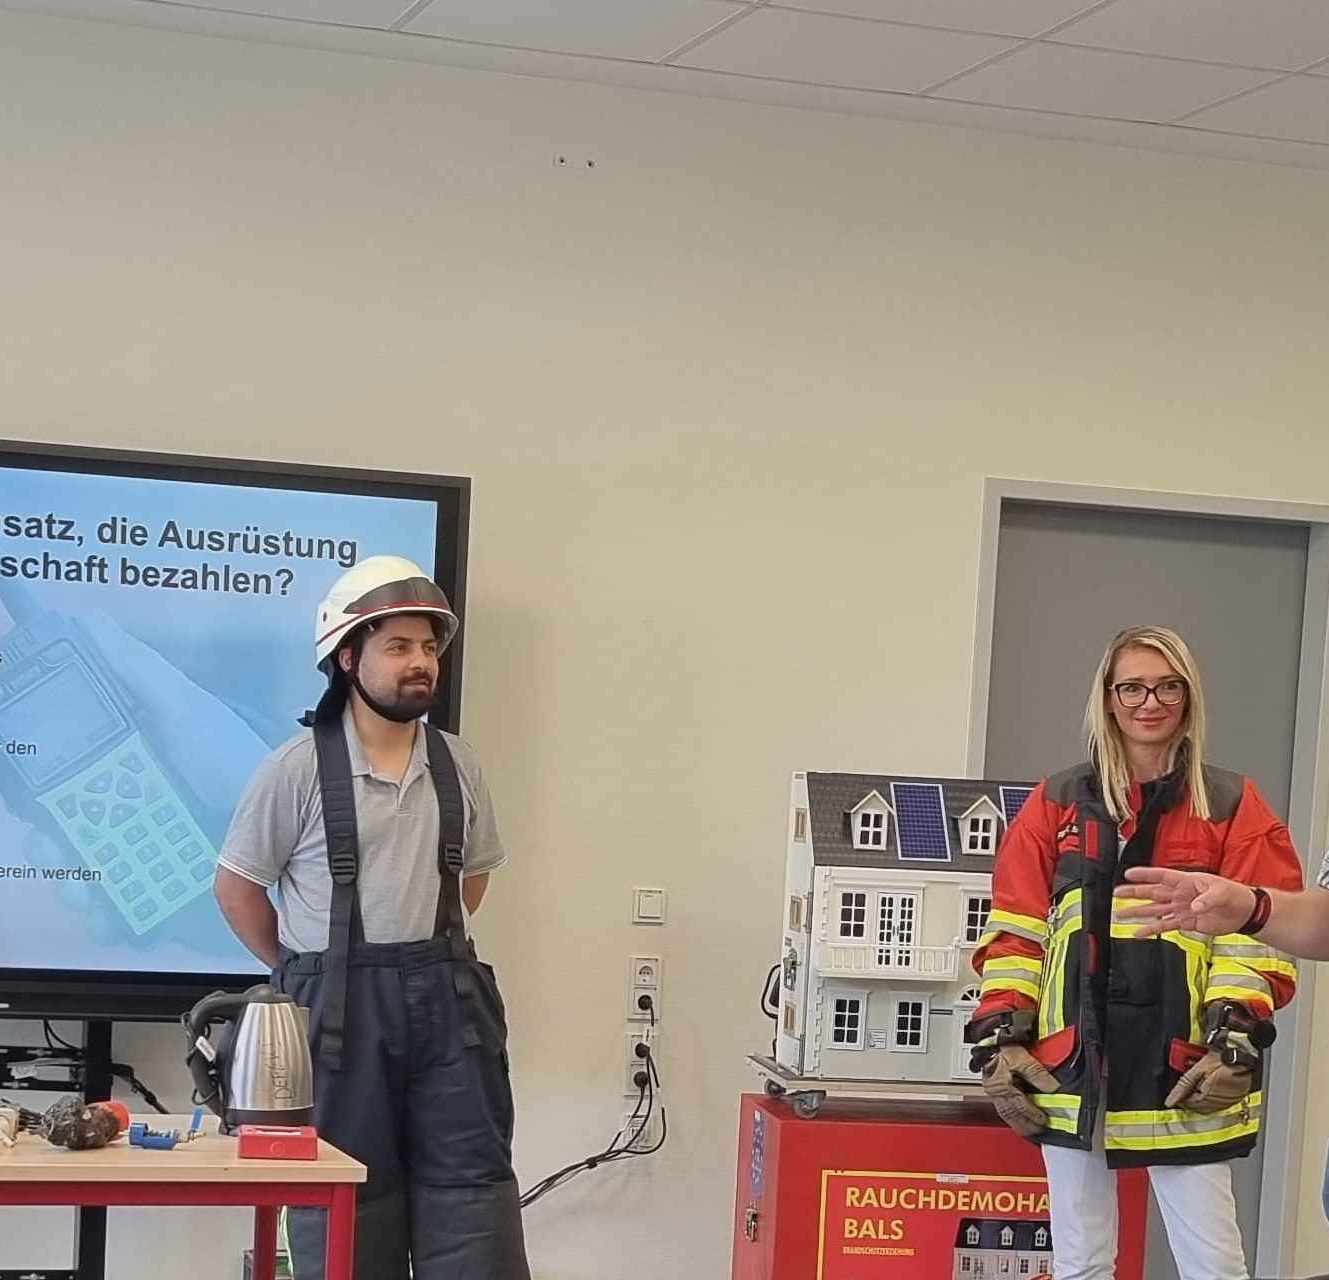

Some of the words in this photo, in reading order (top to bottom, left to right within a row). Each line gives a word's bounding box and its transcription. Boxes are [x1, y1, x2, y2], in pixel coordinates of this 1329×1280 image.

[97, 517, 149, 546] die
[157, 521, 358, 568] Ausrüstung
[119, 557, 295, 596] bezahlen?
[6, 740, 38, 756] den
[42, 865, 103, 882] werden
[844, 1186, 1052, 1214] RAUCHDEMOHA
[843, 1217, 904, 1241] BALS
